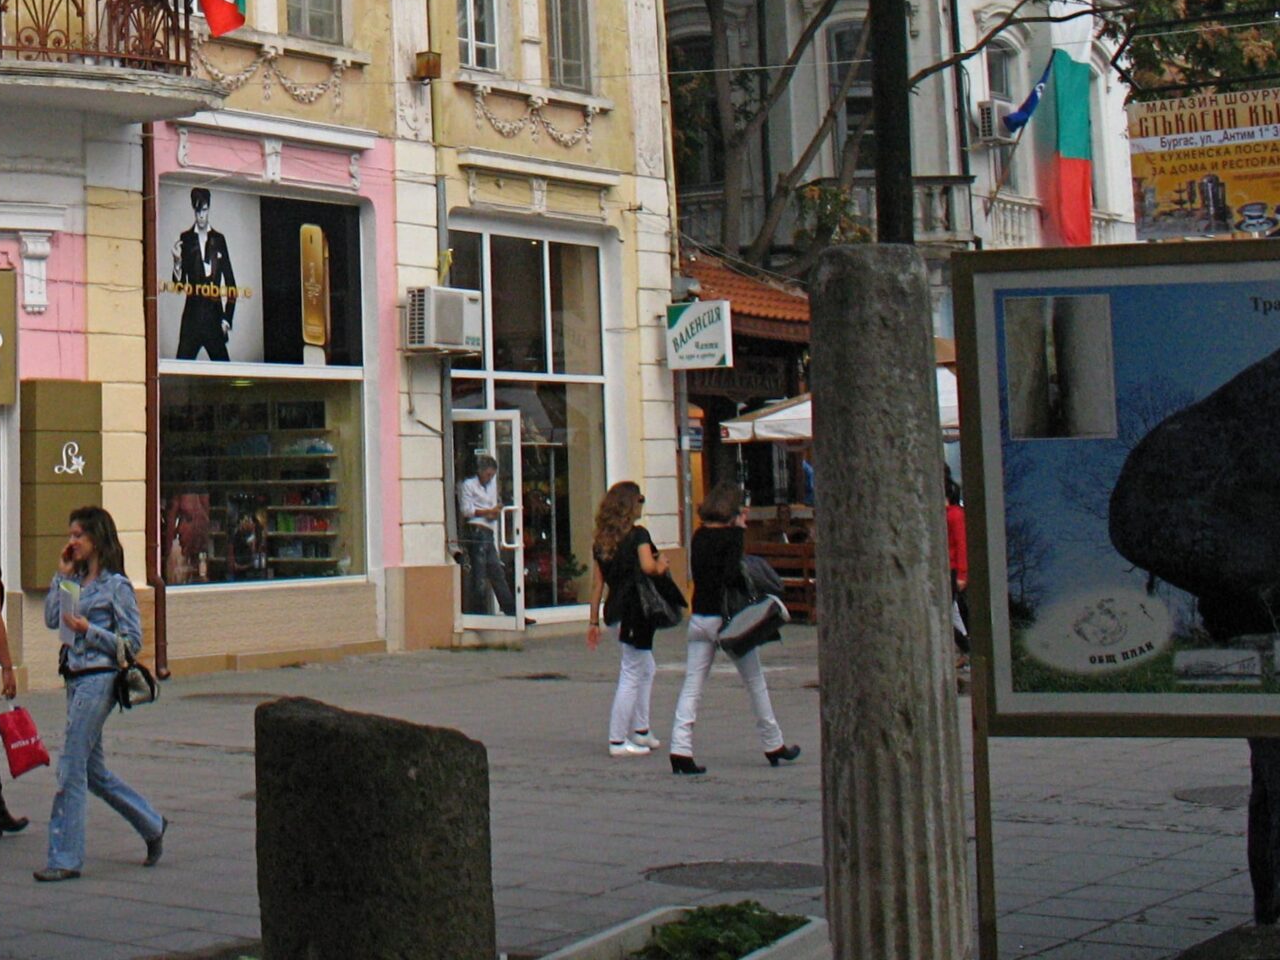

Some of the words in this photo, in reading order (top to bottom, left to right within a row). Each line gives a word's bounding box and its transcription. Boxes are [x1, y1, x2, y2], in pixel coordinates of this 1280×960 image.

[1160, 145, 1231, 162] КУХНЕНСКА
[1151, 165, 1166, 176] ЗА
[1169, 161, 1207, 175] ДОМА
[1211, 160, 1218, 171] И
[672, 306, 721, 353] ВАЛЕНСИЯ
